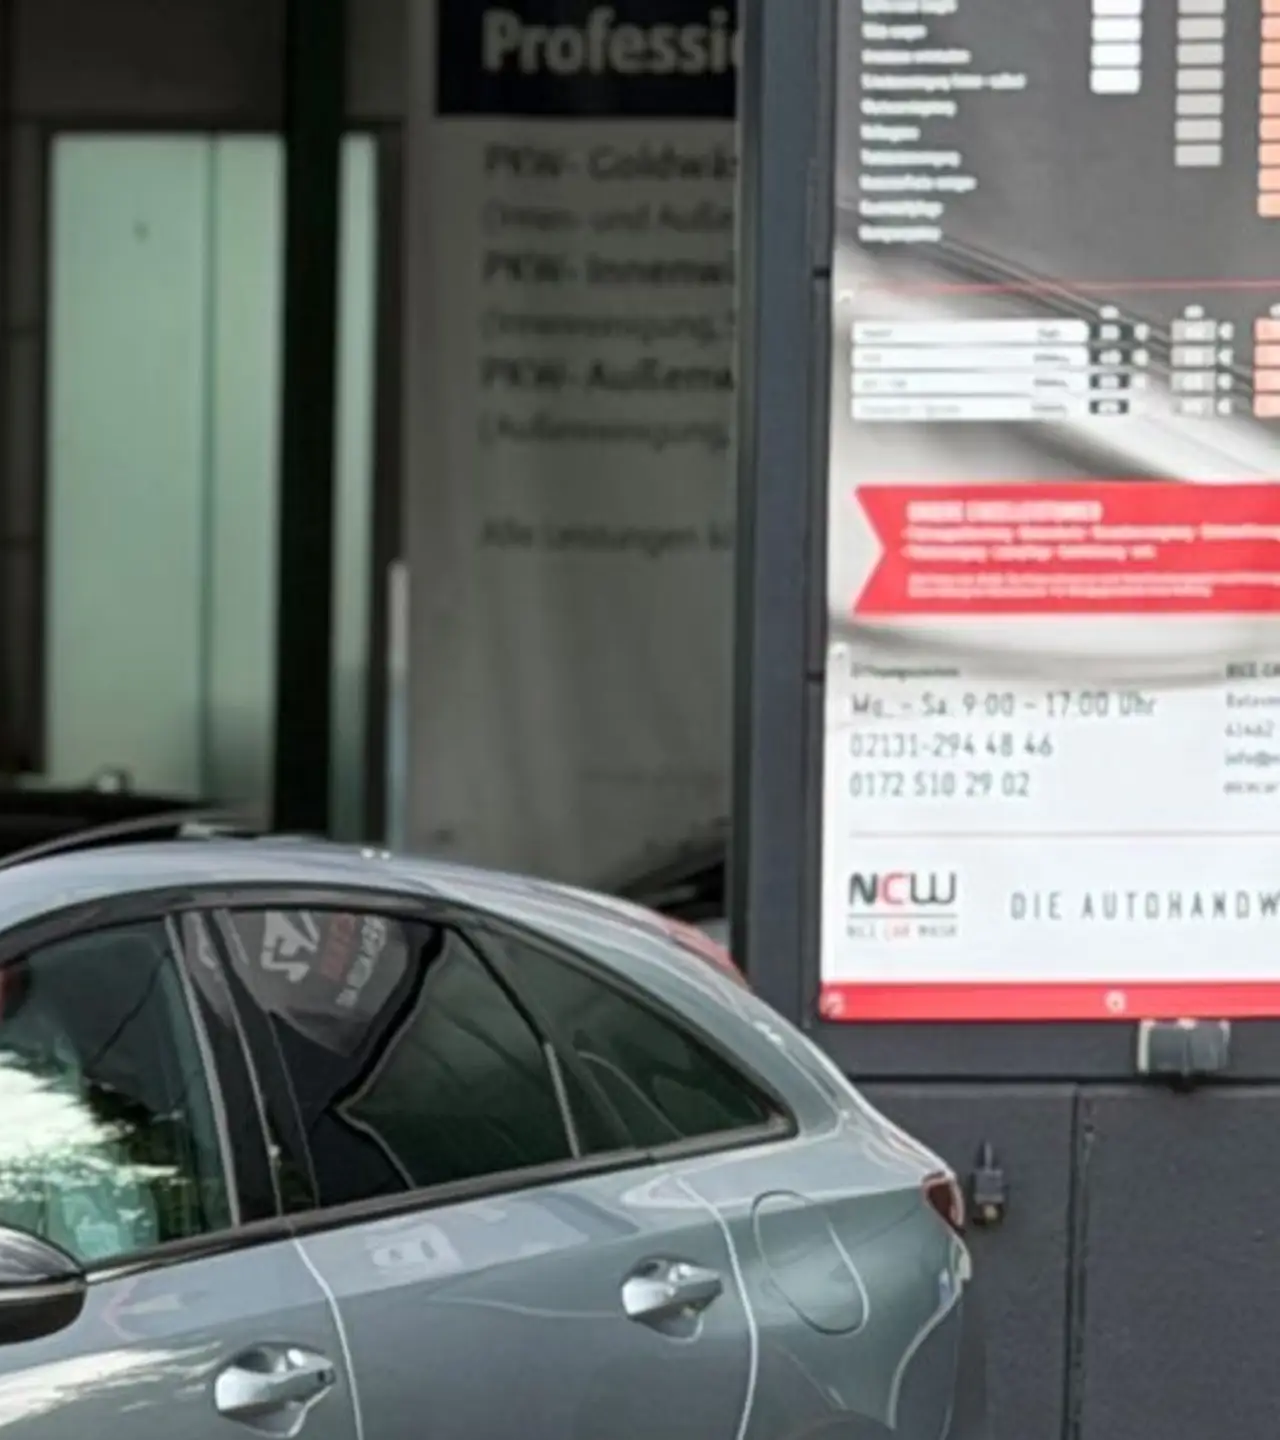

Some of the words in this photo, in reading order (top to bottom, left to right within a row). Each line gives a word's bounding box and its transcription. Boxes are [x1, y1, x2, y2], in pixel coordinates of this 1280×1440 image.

[480, 5, 737, 75] Professi
[1000, 771, 1031, 798] 02
[848, 871, 958, 906] NCW
[1010, 890, 1063, 921] DIE
